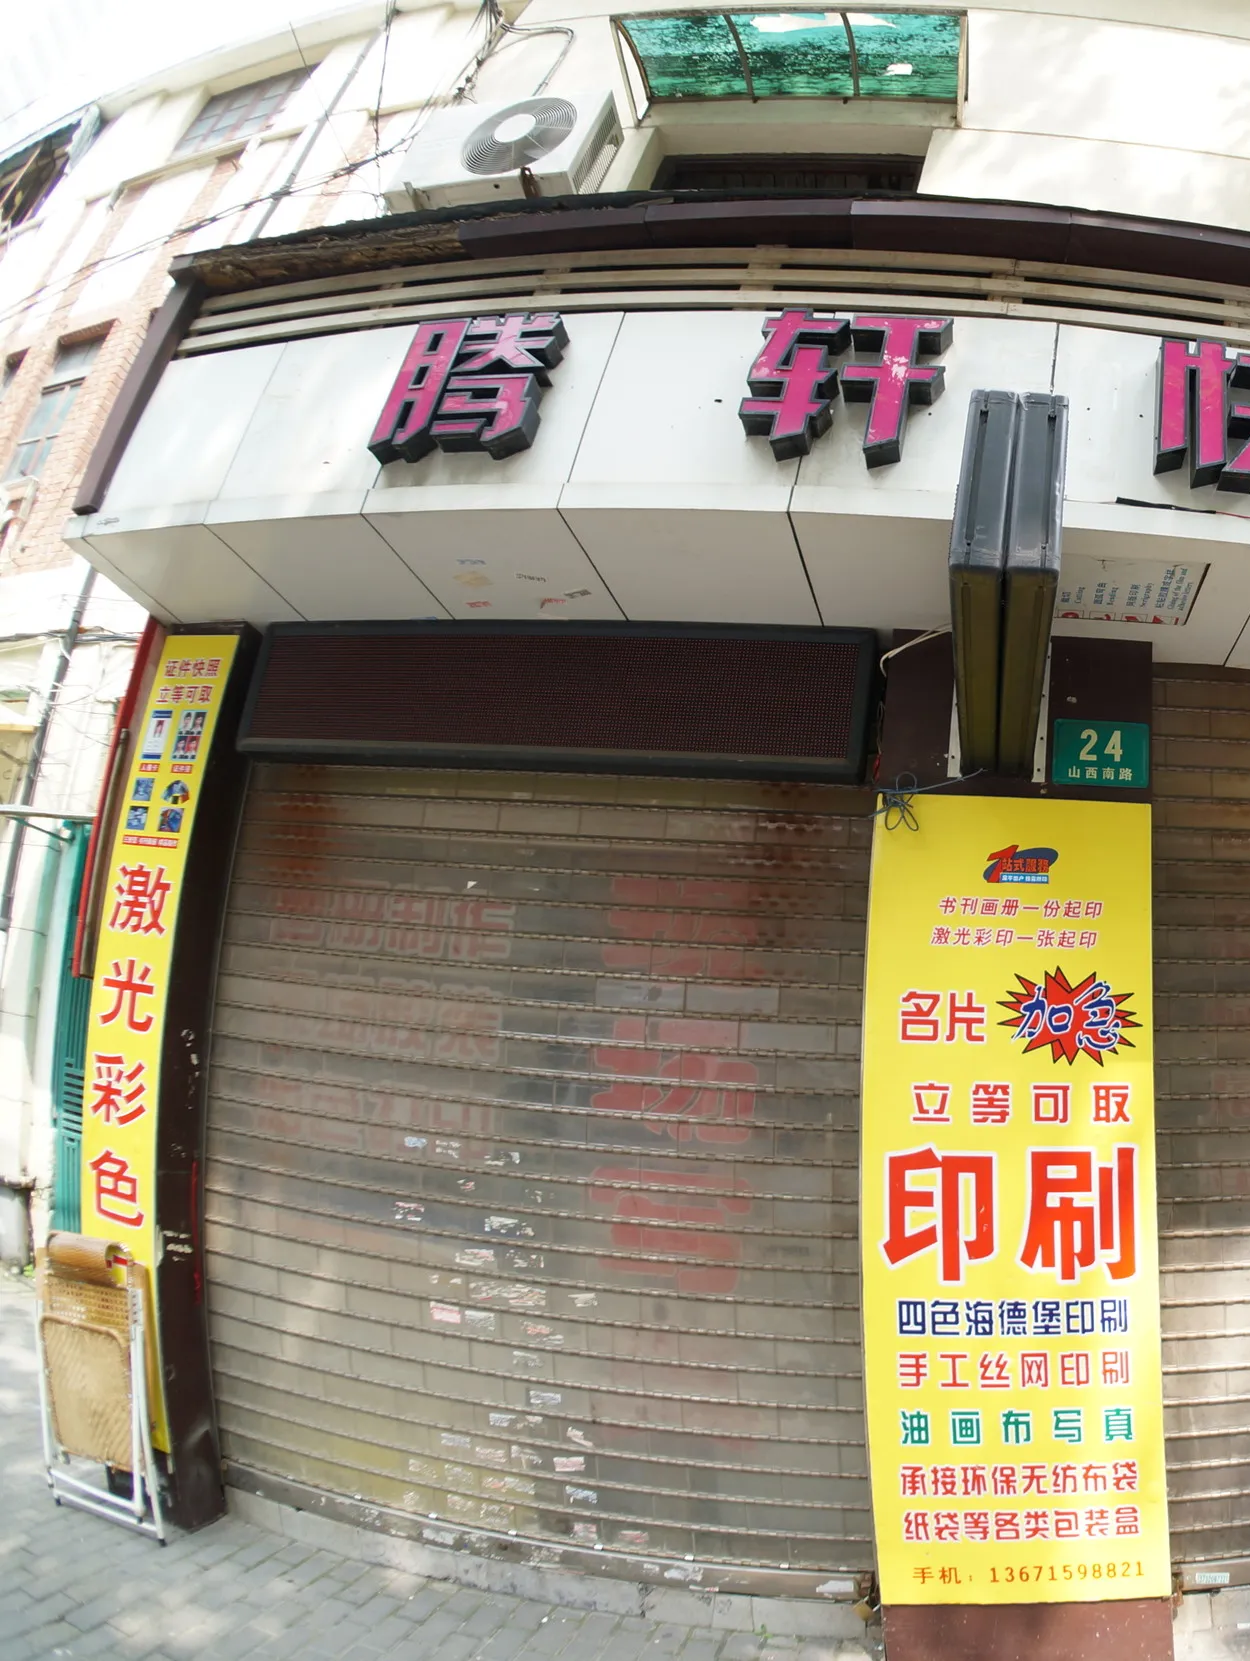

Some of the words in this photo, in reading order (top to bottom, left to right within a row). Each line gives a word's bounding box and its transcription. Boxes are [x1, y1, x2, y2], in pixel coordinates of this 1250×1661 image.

[164, 659, 221, 677] 证件快照
[157, 685, 213, 703] 立等可取
[1079, 729, 1123, 762] 24
[1068, 766, 1133, 781] 山西南路
[939, 897, 1103, 918] 书刊画册一份起印
[931, 927, 1097, 949] 激光彩印一张起印
[901, 990, 986, 1043] 名片
[1012, 980, 1120, 1050] 加急
[89, 864, 172, 1270] 激光彩色
[912, 1082, 1130, 1123] 立等可取
[882, 1146, 1136, 1282] 印刷
[898, 1299, 1128, 1336] 四色海德堡印刷
[898, 1351, 1130, 1388] 手工丝网印刷
[901, 1408, 1133, 1445] 油画布写真
[901, 1461, 1138, 1496] 承接环保无纺布袋
[904, 1506, 1140, 1541] 纸袋等各类包装盒
